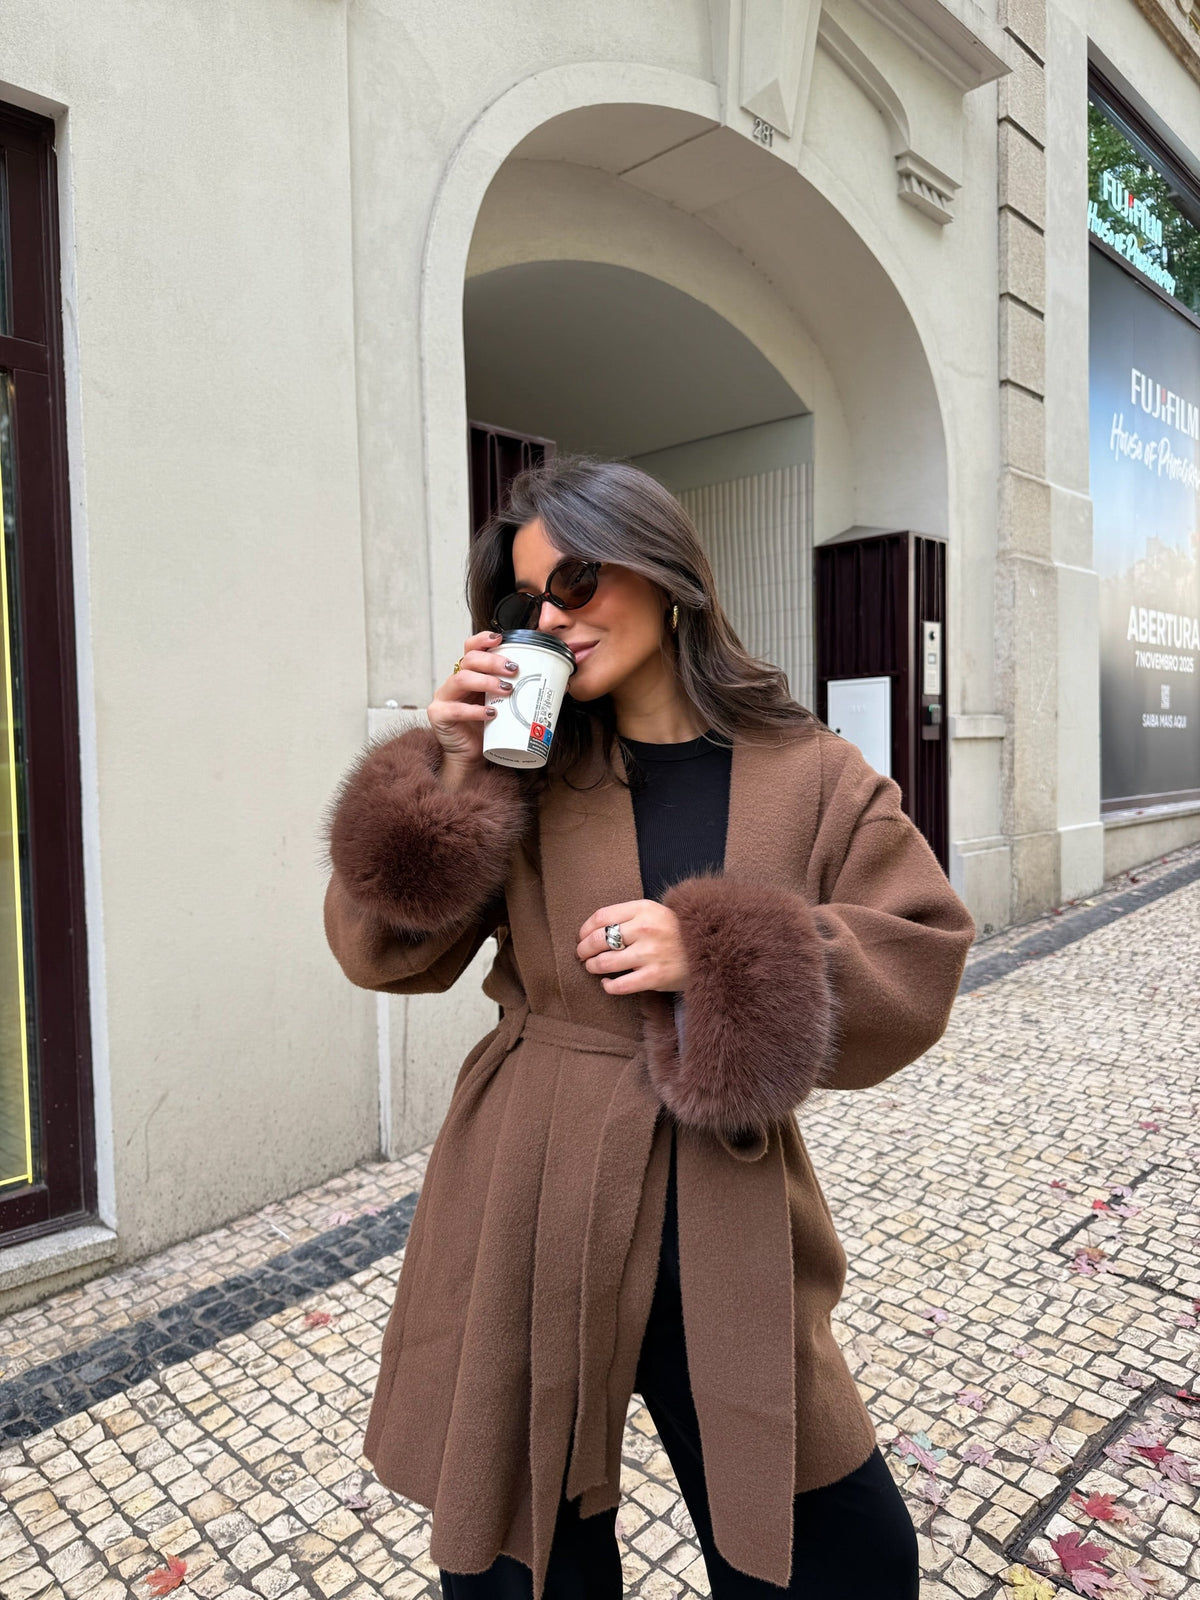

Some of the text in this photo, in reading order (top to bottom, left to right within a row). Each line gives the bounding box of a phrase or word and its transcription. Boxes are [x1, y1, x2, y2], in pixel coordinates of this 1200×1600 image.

[1102, 170, 1163, 247] FUJIFILM
[1131, 367, 1199, 441] FUJIFILM
[1127, 605, 1200, 650] ABERTURA
[1140, 651, 1178, 672] NOVEMBRO
[1179, 655, 1194, 673] 2025
[1159, 714, 1173, 729] MAIS
